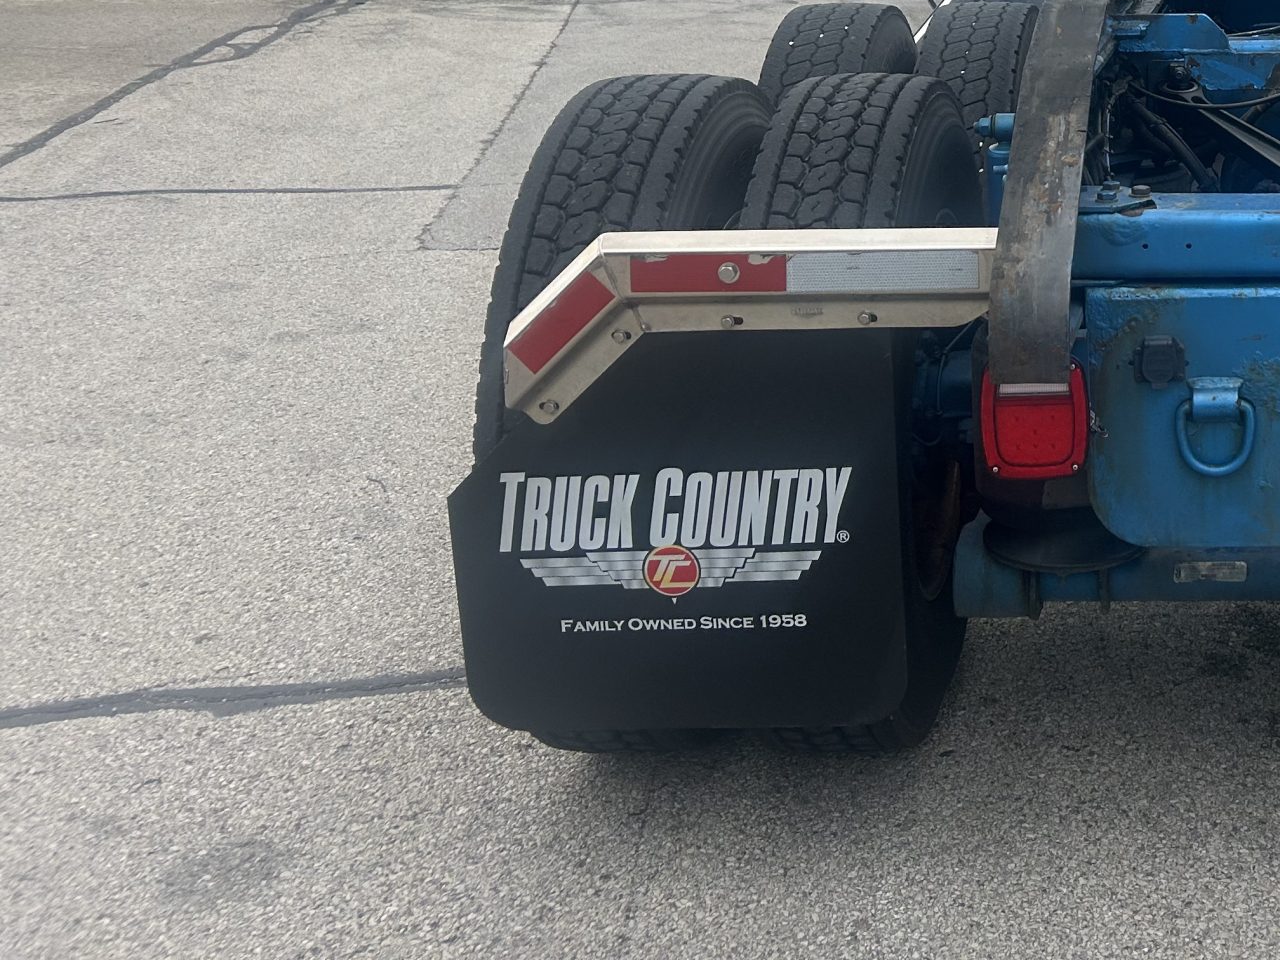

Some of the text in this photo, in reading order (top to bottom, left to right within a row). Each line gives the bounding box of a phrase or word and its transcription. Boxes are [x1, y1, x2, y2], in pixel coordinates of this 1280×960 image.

[499, 467, 853, 553] TRUCK COUNTRY
[560, 614, 808, 633] FAMILY OWNED SINCE 1958
